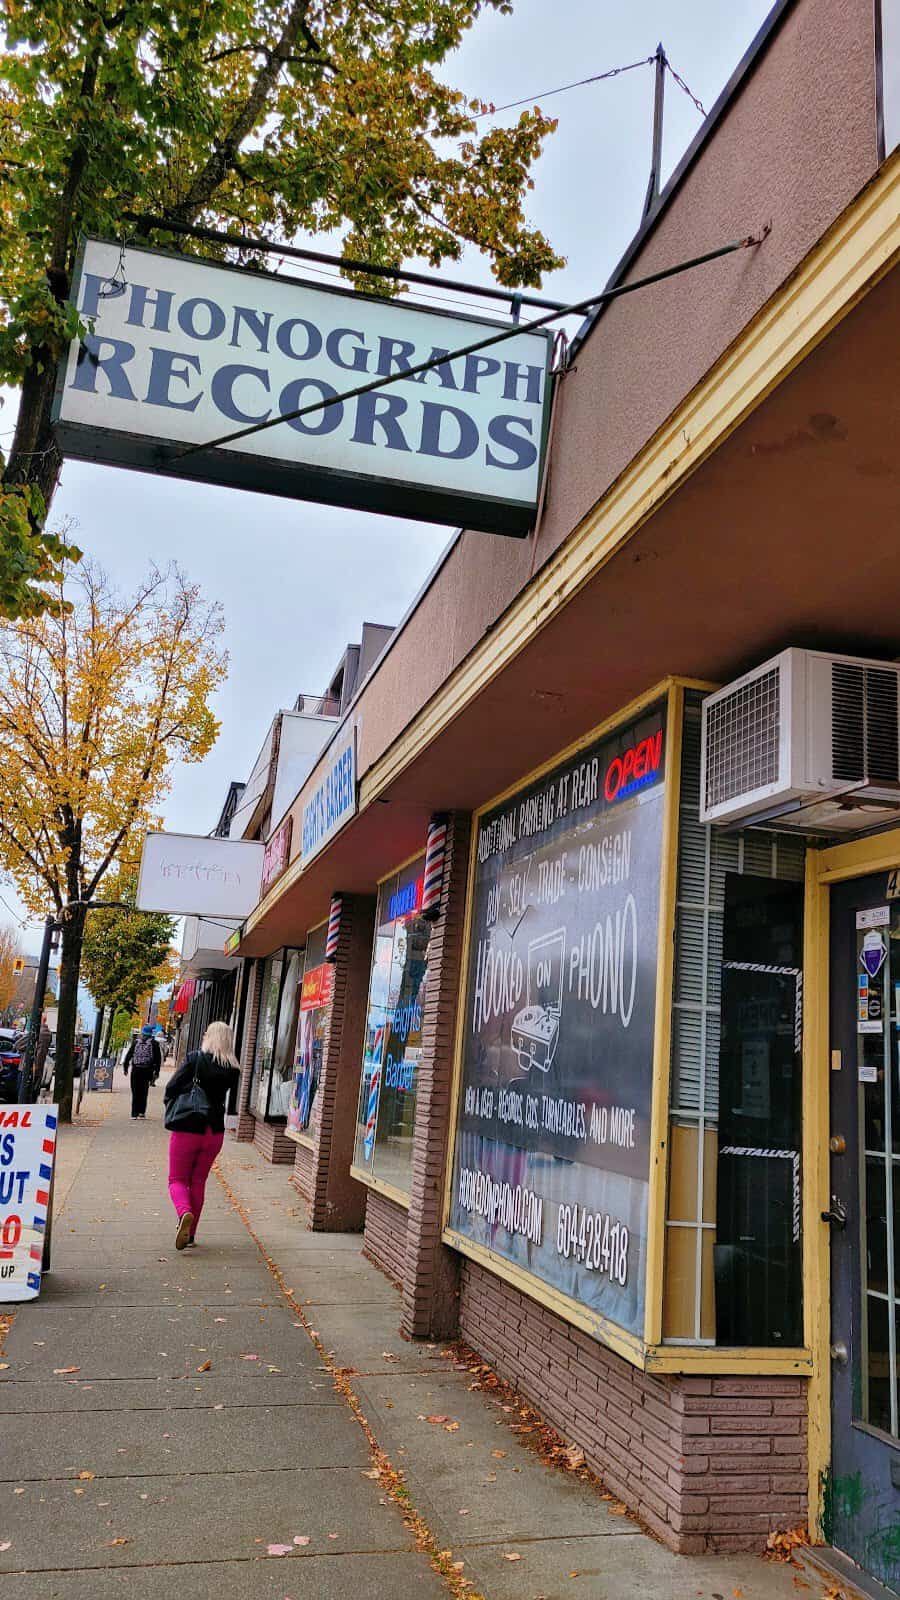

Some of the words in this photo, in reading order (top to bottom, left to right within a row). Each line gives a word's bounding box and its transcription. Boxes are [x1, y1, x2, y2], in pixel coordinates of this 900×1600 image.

[77, 273, 544, 404] PHONOGRAPH
[68, 334, 539, 471] RECORDS
[604, 729, 663, 802] OPEN
[478, 807, 517, 864] ADDITIONAL
[518, 785, 555, 841] PARKING
[556, 774, 570, 818] AT
[571, 757, 599, 811] REAR
[486, 884, 502, 927] BUY
[537, 852, 568, 905] TRADE
[577, 830, 632, 892] CONSIGN
[472, 939, 523, 1033] HOOKED
[536, 959, 552, 989] ON
[568, 893, 637, 1028] PHONO
[721, 961, 799, 976] METALLICA
[389, 997, 422, 1042] eights
[793, 970, 802, 1054] BLACKLIST
[385, 1053, 414, 1089] Barber
[590, 1102, 607, 1147] AND
[609, 1106, 636, 1148] MORE
[720, 1146, 797, 1159] METALLICA
[458, 1167, 544, 1246] HOOKEDONPHONO.COM
[556, 1203, 629, 1286] 604.428.4118
[792, 1153, 800, 1243] BLACKLIST
[0, 1265, 15, 1279] UP
